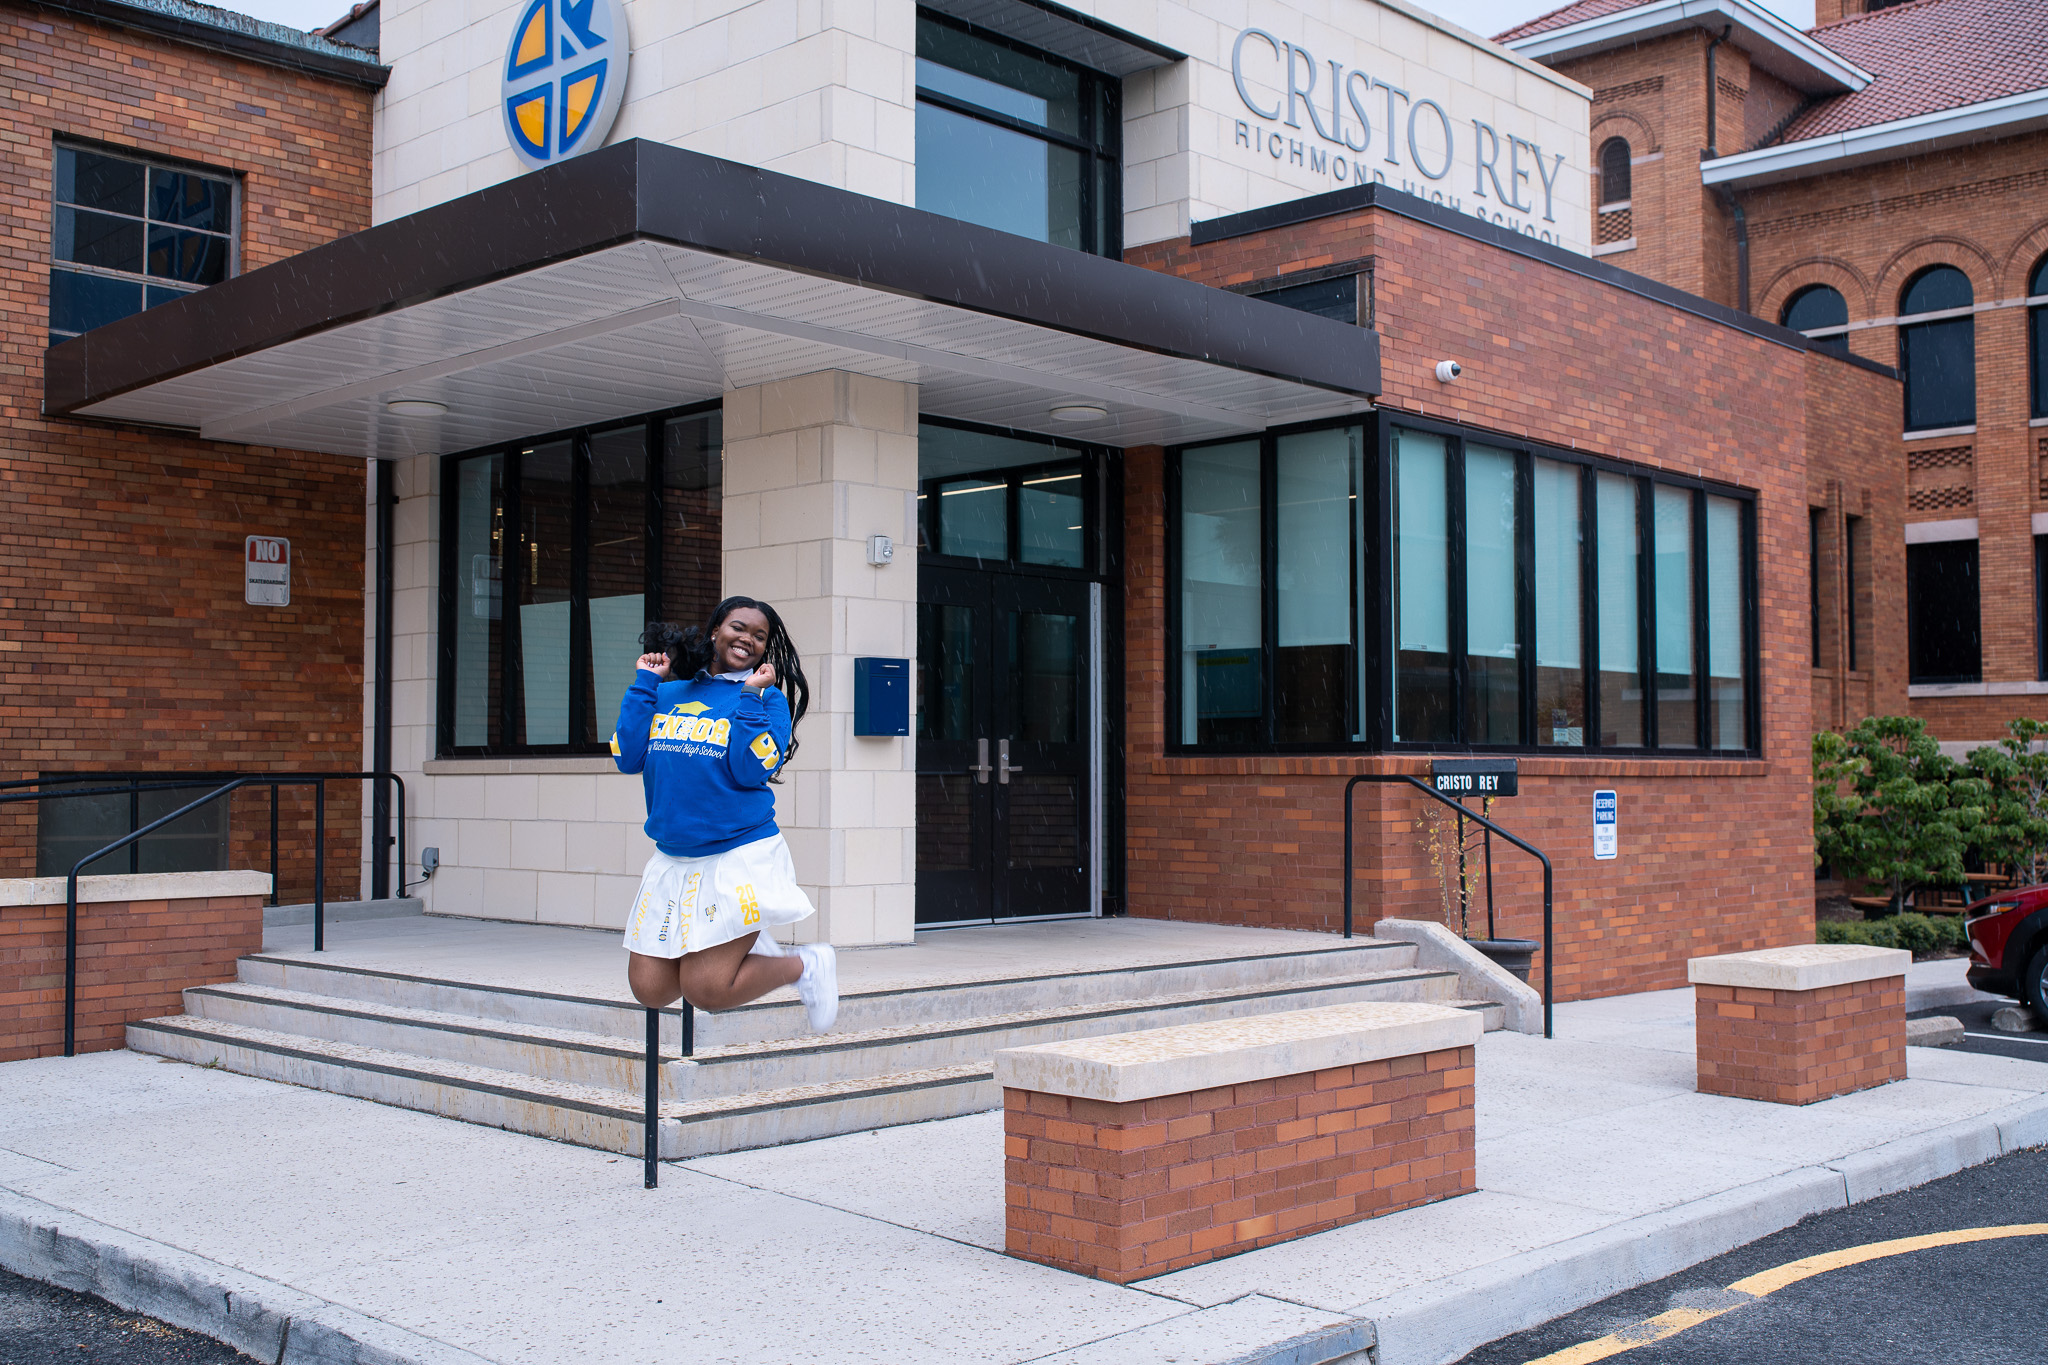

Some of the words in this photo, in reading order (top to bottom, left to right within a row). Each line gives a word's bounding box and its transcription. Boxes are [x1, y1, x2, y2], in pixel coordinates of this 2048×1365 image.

[1232, 27, 1454, 181] CRISTO
[1471, 118, 1566, 223] REY
[1235, 119, 1386, 186] RICHMOND
[255, 540, 280, 562] NO
[248, 578, 287, 586] SKATEBOARDING
[652, 740, 683, 753] Richmond
[681, 743, 700, 758] High
[699, 745, 727, 760] School
[1436, 774, 1473, 791] CRISTO
[1478, 775, 1499, 791] REY
[1596, 798, 1615, 809] RESERVED
[1596, 811, 1615, 821] PARKING
[735, 883, 756, 904] 20
[740, 901, 761, 926] 26
